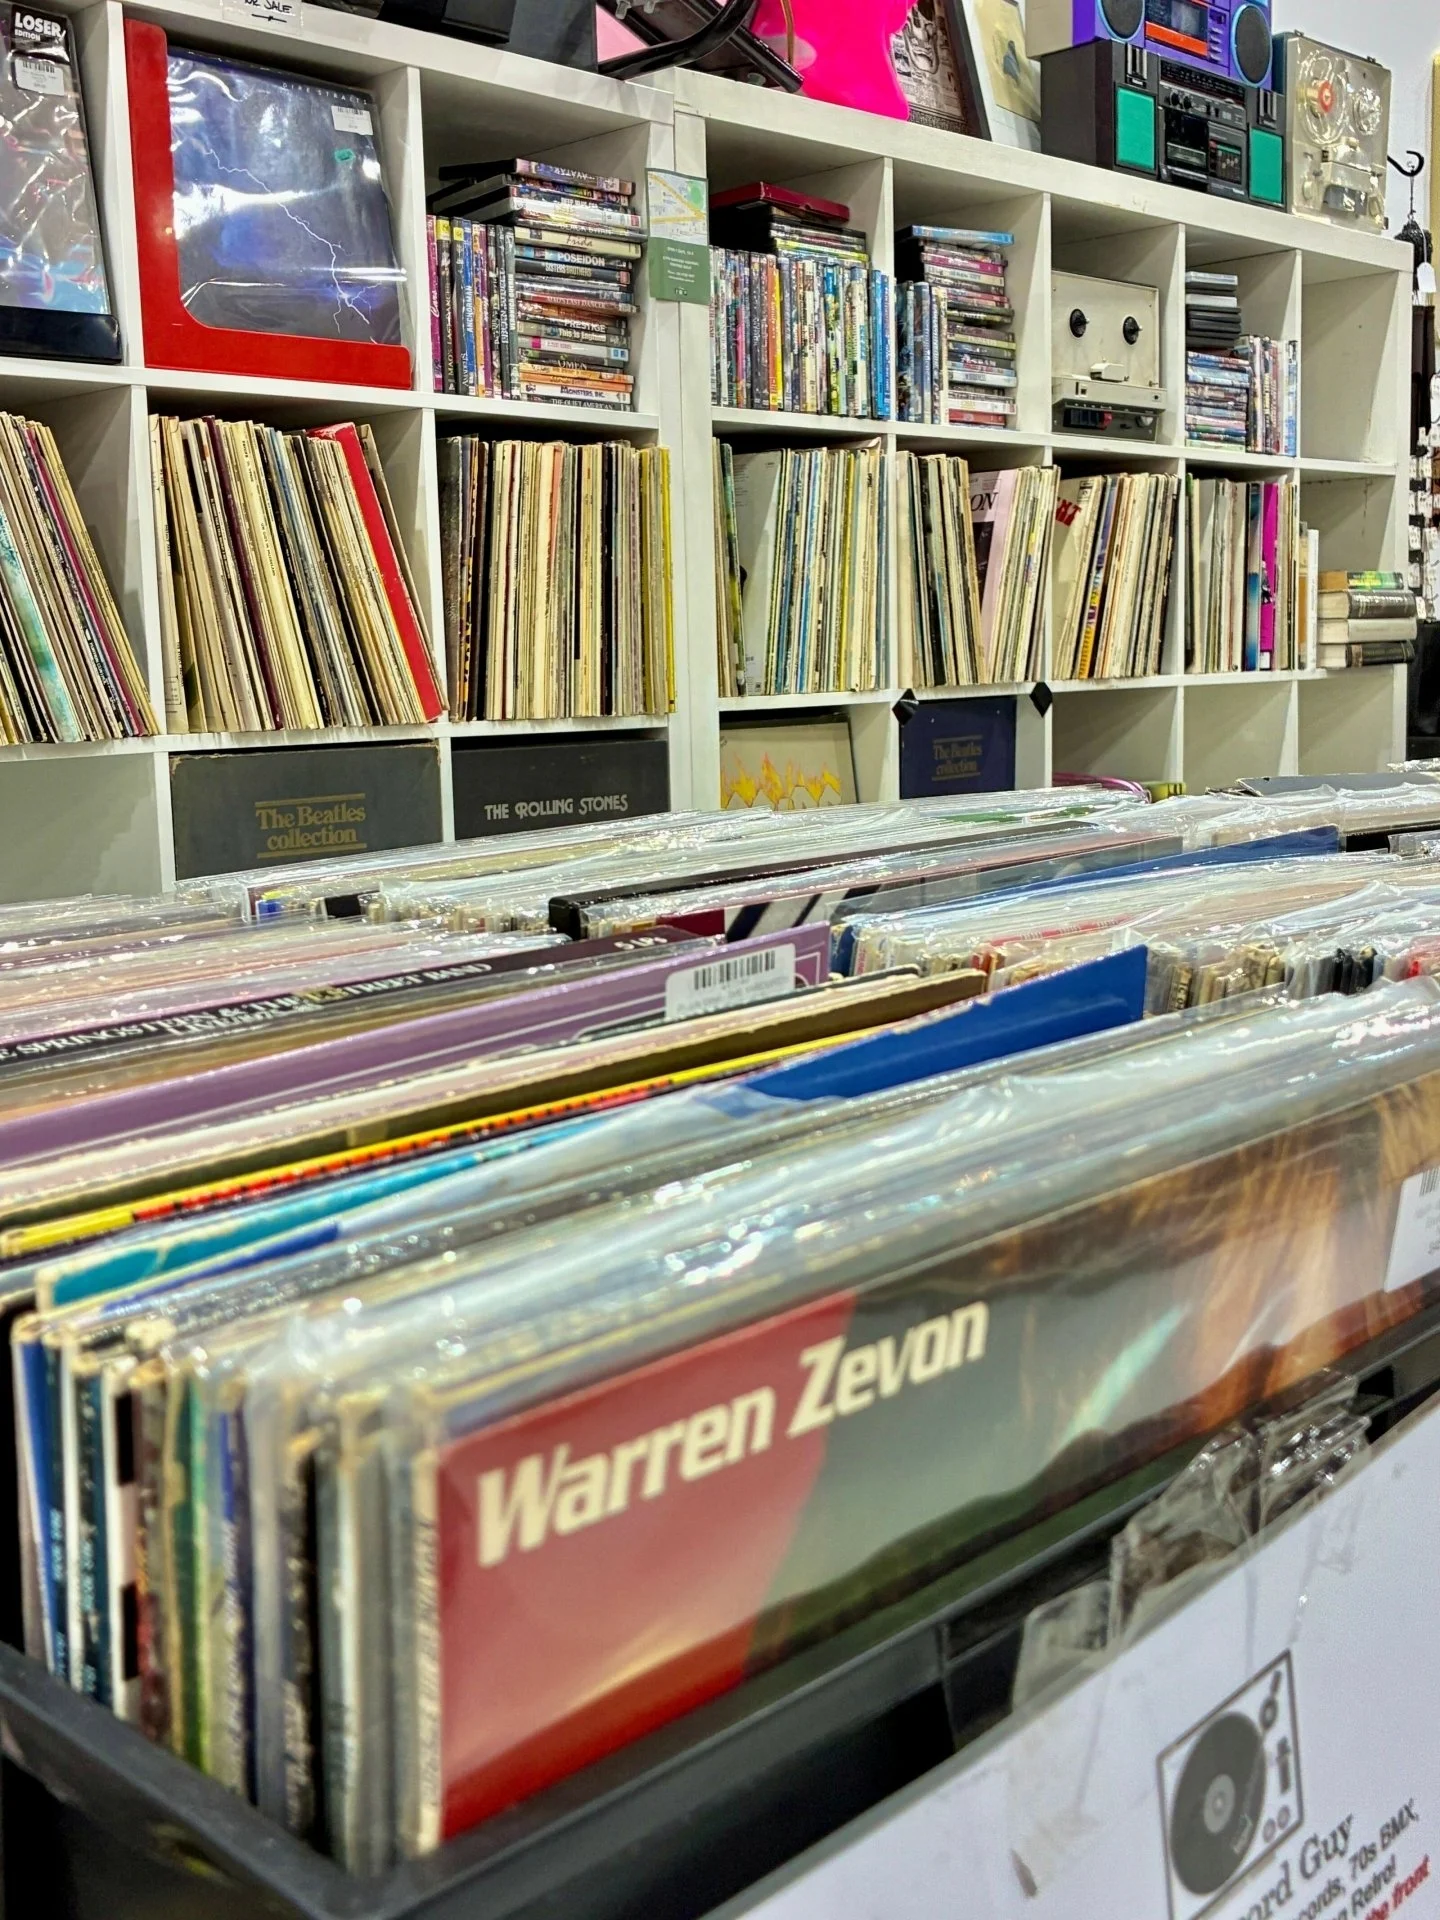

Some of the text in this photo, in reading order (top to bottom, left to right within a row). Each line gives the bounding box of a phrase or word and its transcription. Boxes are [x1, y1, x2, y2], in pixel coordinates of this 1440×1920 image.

[264, 0, 292, 13] SALE
[15, 12, 62, 37] LOSER
[15, 28, 41, 41] EDITION
[566, 233, 593, 247] Frida
[557, 251, 606, 267] POSEIDON
[465, 285, 474, 332] ANCHORMAN
[560, 327, 572, 338] This
[564, 319, 607, 333] PRESTIGE
[933, 739, 983, 760] The Beatles
[936, 760, 978, 776] collection
[256, 804, 367, 831] The Beatles
[484, 794, 629, 820] THE ROLLING STONES
[267, 827, 358, 851] collection
[16, 1010, 218, 1055] SPRINGSTEEN
[422, 962, 493, 982] BAND
[477, 1300, 990, 1568] Warren Zevon
[1239, 1812, 1354, 1920] ord Guy
[1348, 1841, 1377, 1881] 70s
[1351, 1853, 1397, 1917] Retro!
[1391, 1852, 1431, 1910] front
